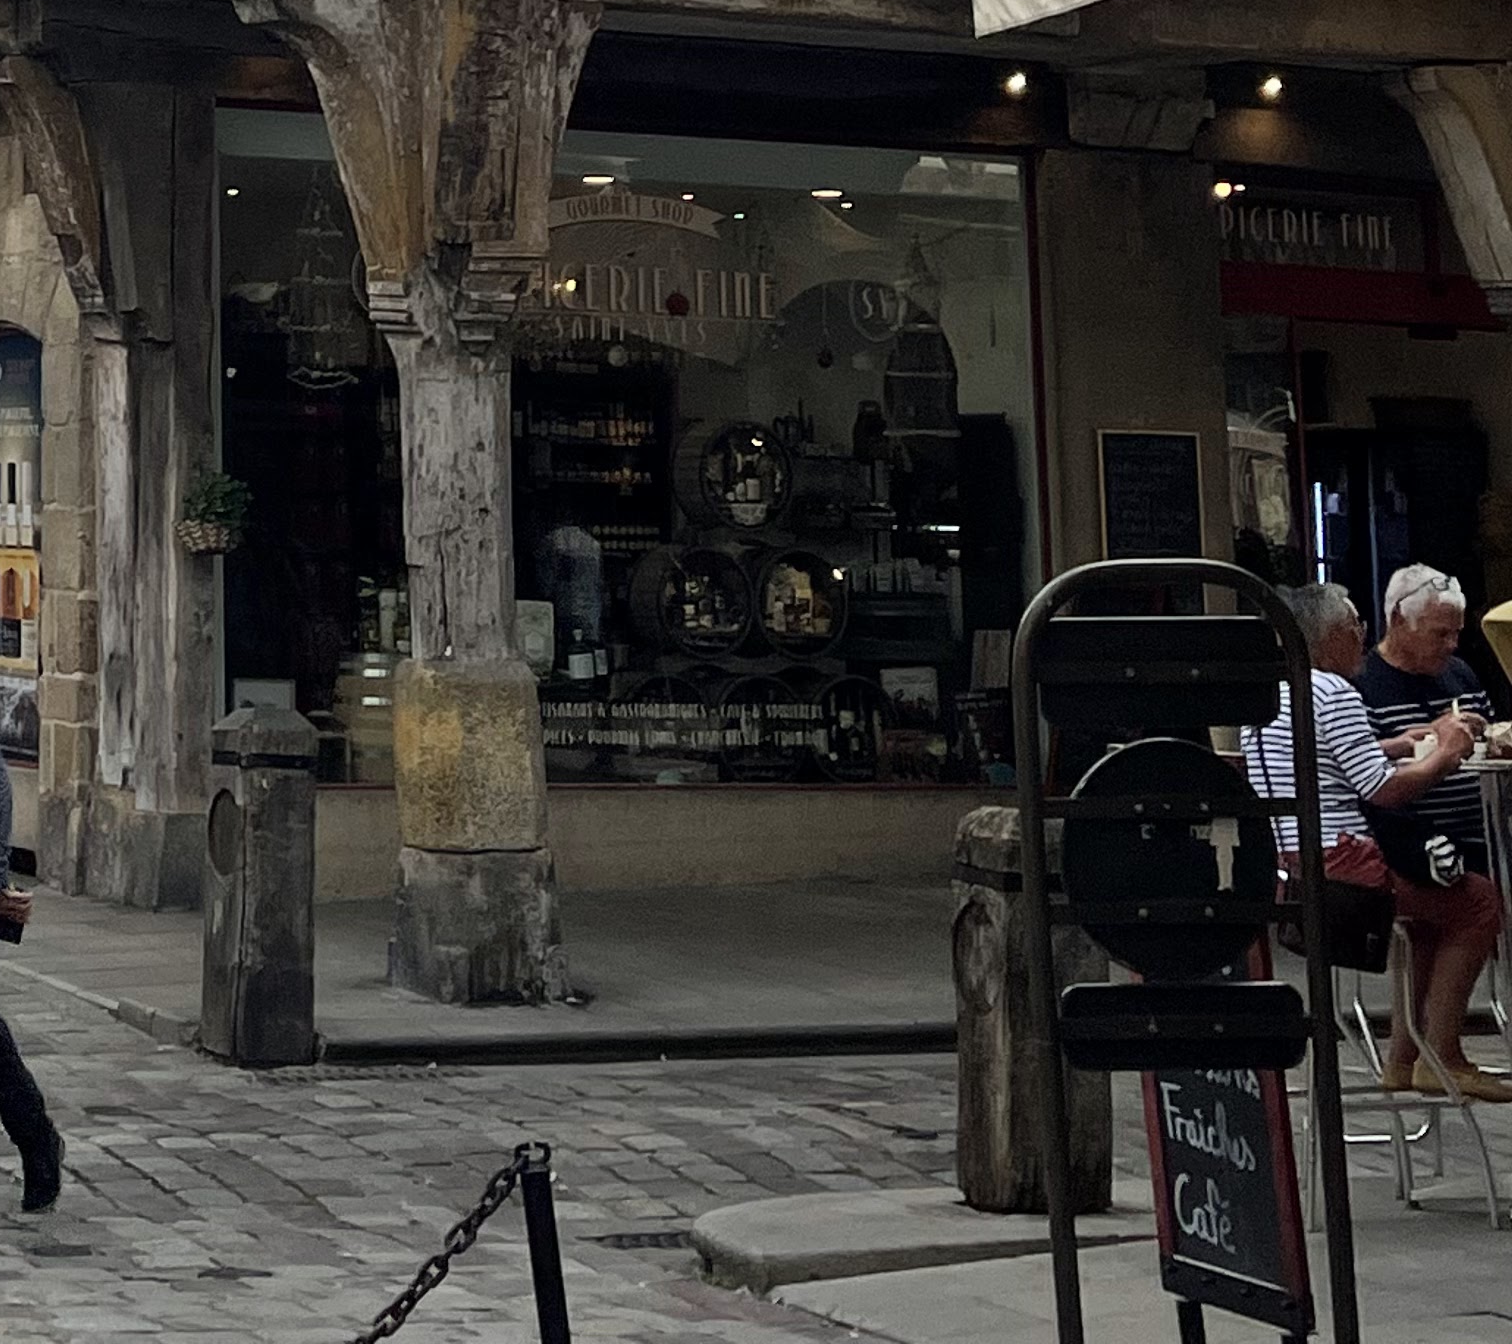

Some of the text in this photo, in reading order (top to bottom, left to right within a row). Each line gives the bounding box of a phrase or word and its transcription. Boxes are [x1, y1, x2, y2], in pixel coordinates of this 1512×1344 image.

[565, 194, 695, 225] GOURMET SHOP
[694, 268, 778, 320] FINE
[553, 315, 626, 342] SAINT
[1173, 1173, 1236, 1253] Café
